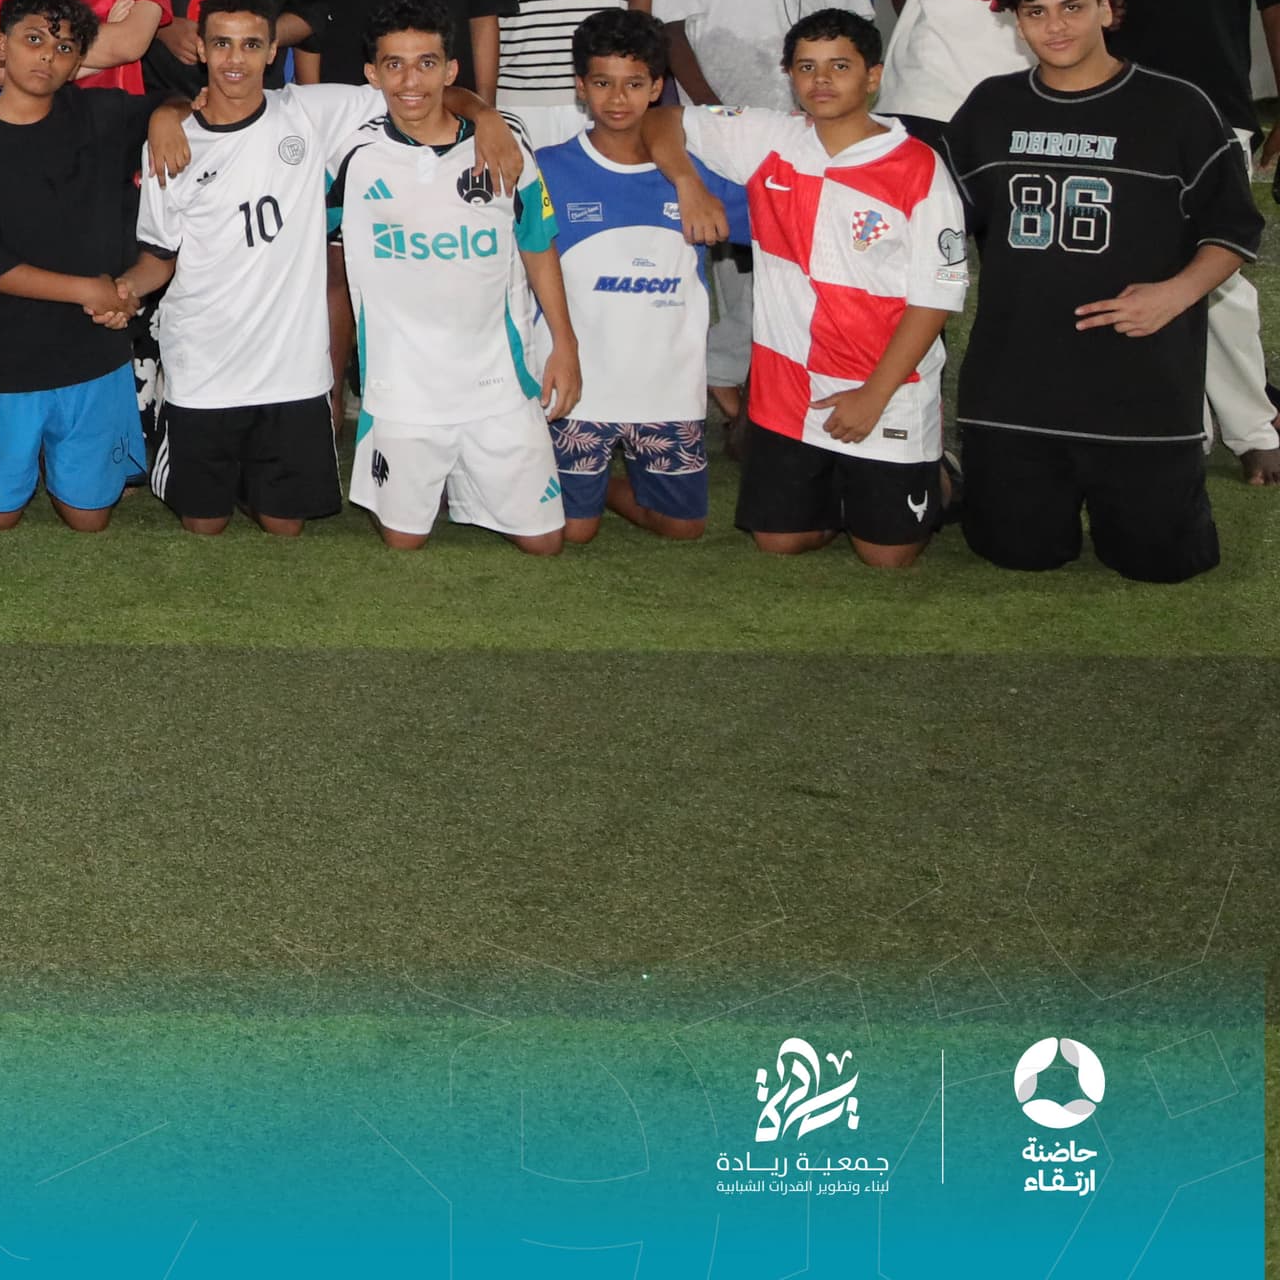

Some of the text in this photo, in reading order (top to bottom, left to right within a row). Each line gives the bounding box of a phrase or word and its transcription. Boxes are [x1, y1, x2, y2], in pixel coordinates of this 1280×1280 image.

[1009, 131, 1117, 160] DHROEN
[239, 195, 283, 247] 10
[1008, 174, 1112, 254] 86
[410, 225, 498, 260] sela
[592, 275, 682, 294] MASCOT
